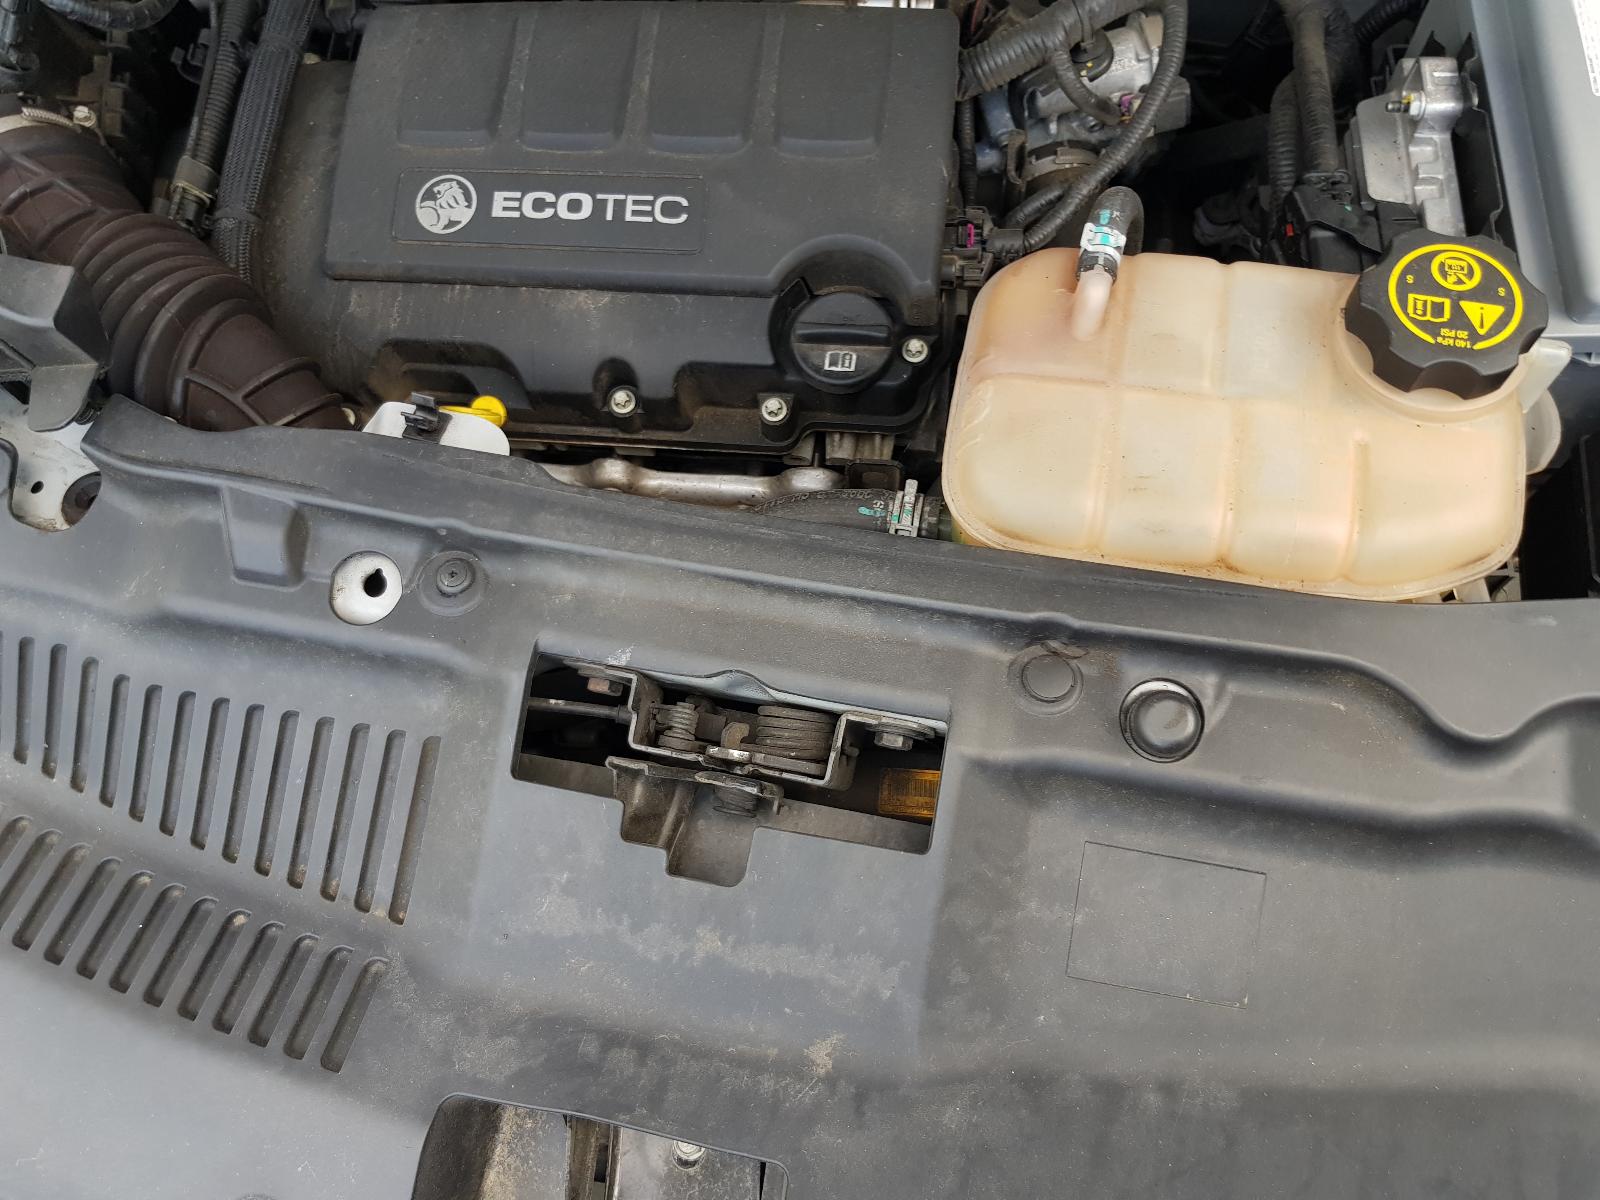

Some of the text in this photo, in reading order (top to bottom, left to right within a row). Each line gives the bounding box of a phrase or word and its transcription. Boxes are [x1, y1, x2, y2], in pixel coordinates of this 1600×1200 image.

[491, 191, 689, 224] ECOTEC
[1406, 275, 1414, 284] S
[1497, 288, 1506, 297] S
[1440, 328, 1469, 339] 20 PSI
[1436, 337, 1472, 349] 140 kPa
